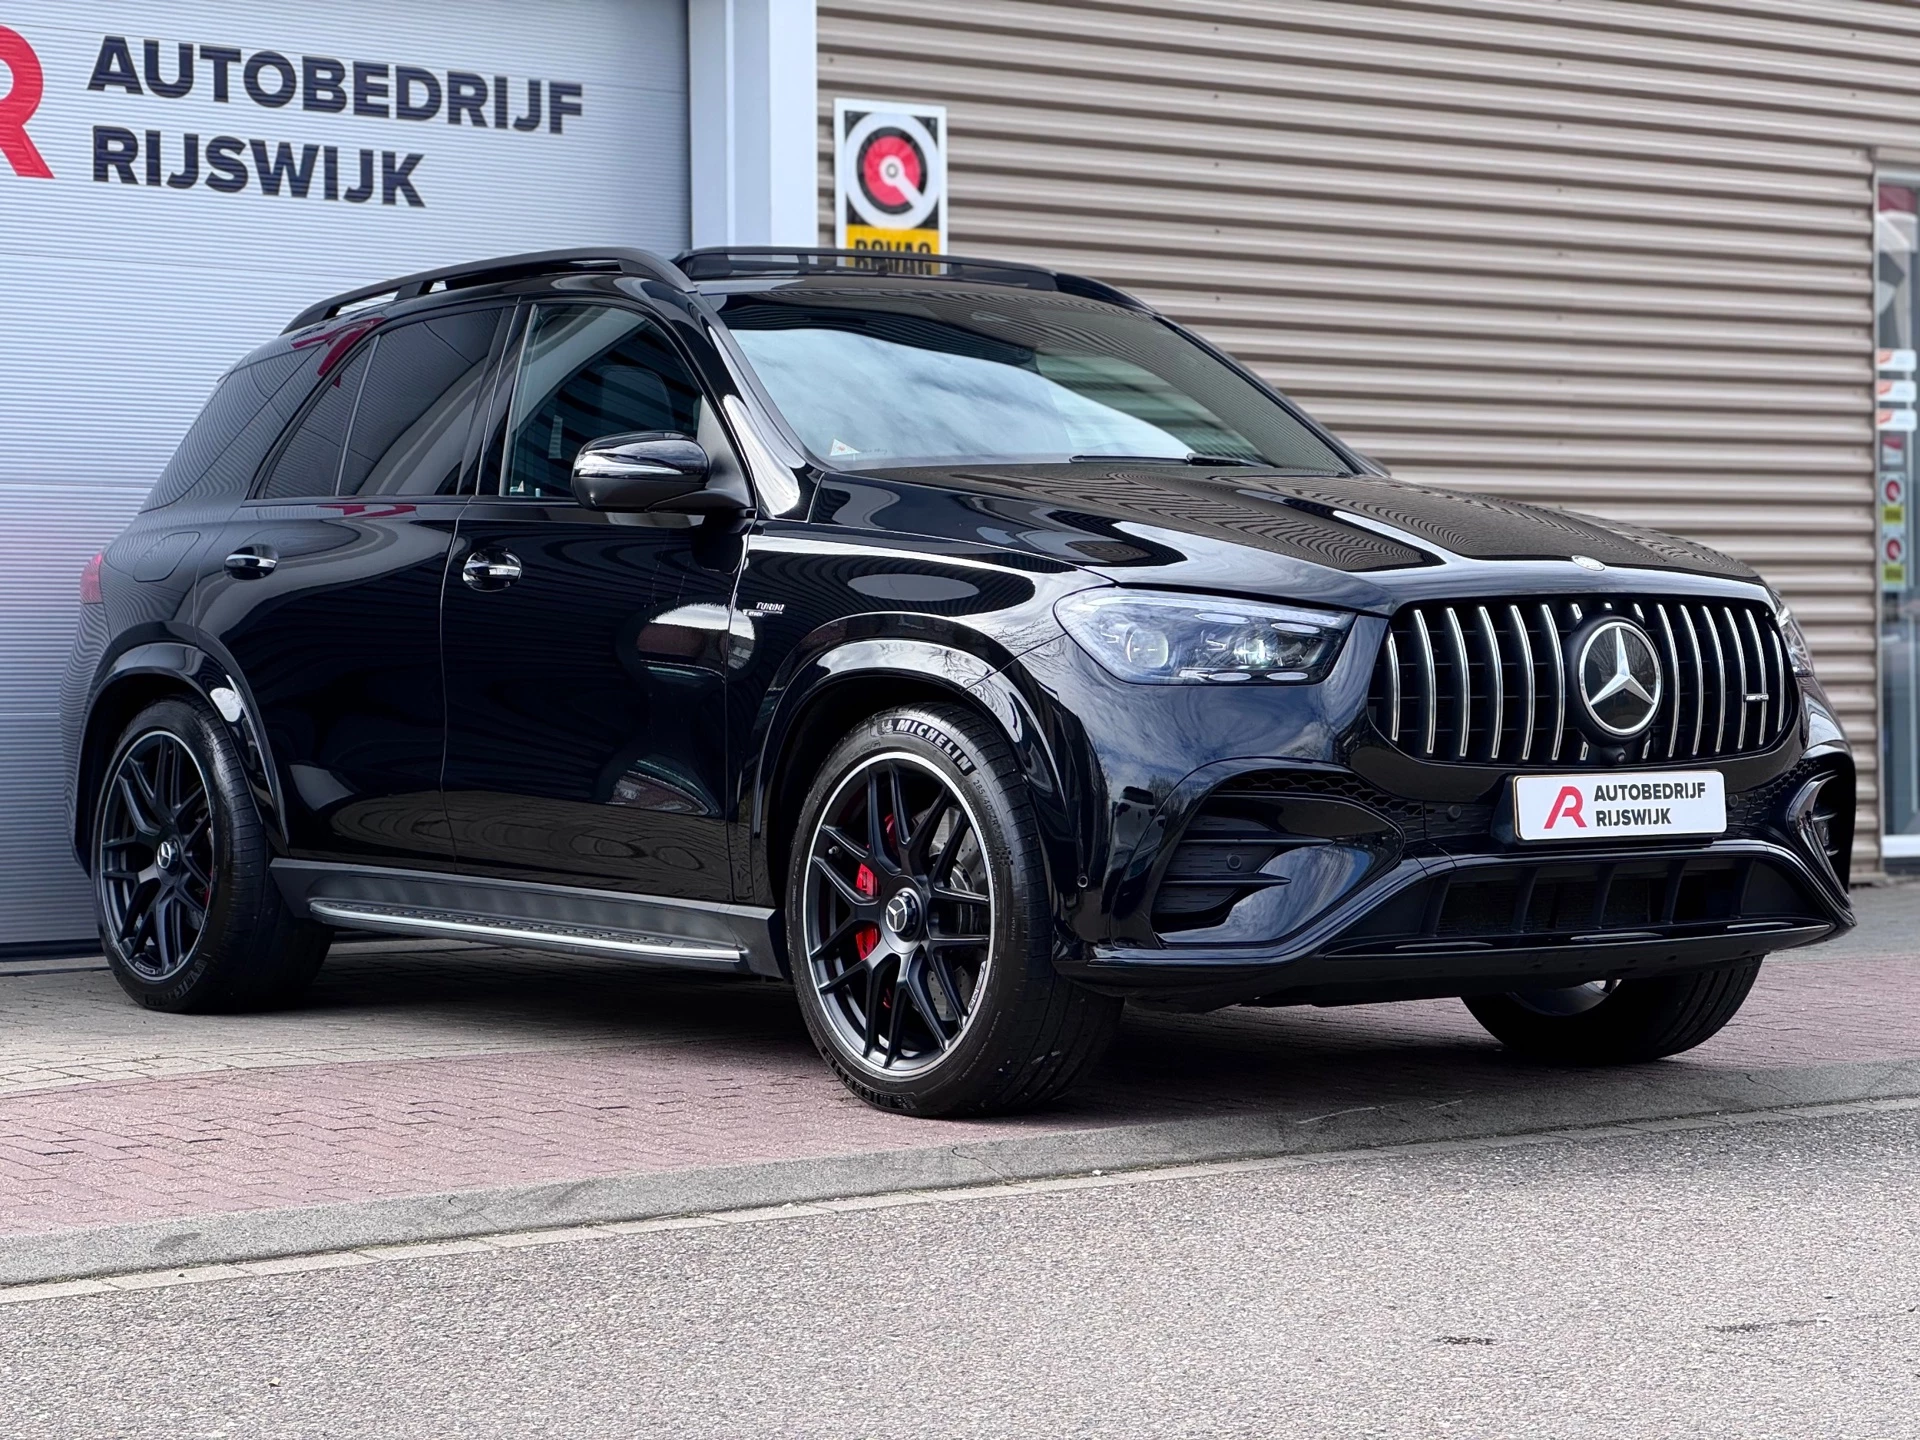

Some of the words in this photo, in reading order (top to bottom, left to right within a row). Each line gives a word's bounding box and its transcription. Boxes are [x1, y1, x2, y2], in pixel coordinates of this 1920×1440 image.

[87, 35, 582, 135] AUTOBEDRIJF
[92, 125, 427, 208] RIJSWIJK
[896, 719, 972, 771] MICHELIN
[1594, 782, 1706, 802] AUTOBEDRIJF
[1596, 808, 1672, 827] RIJSWIJK
